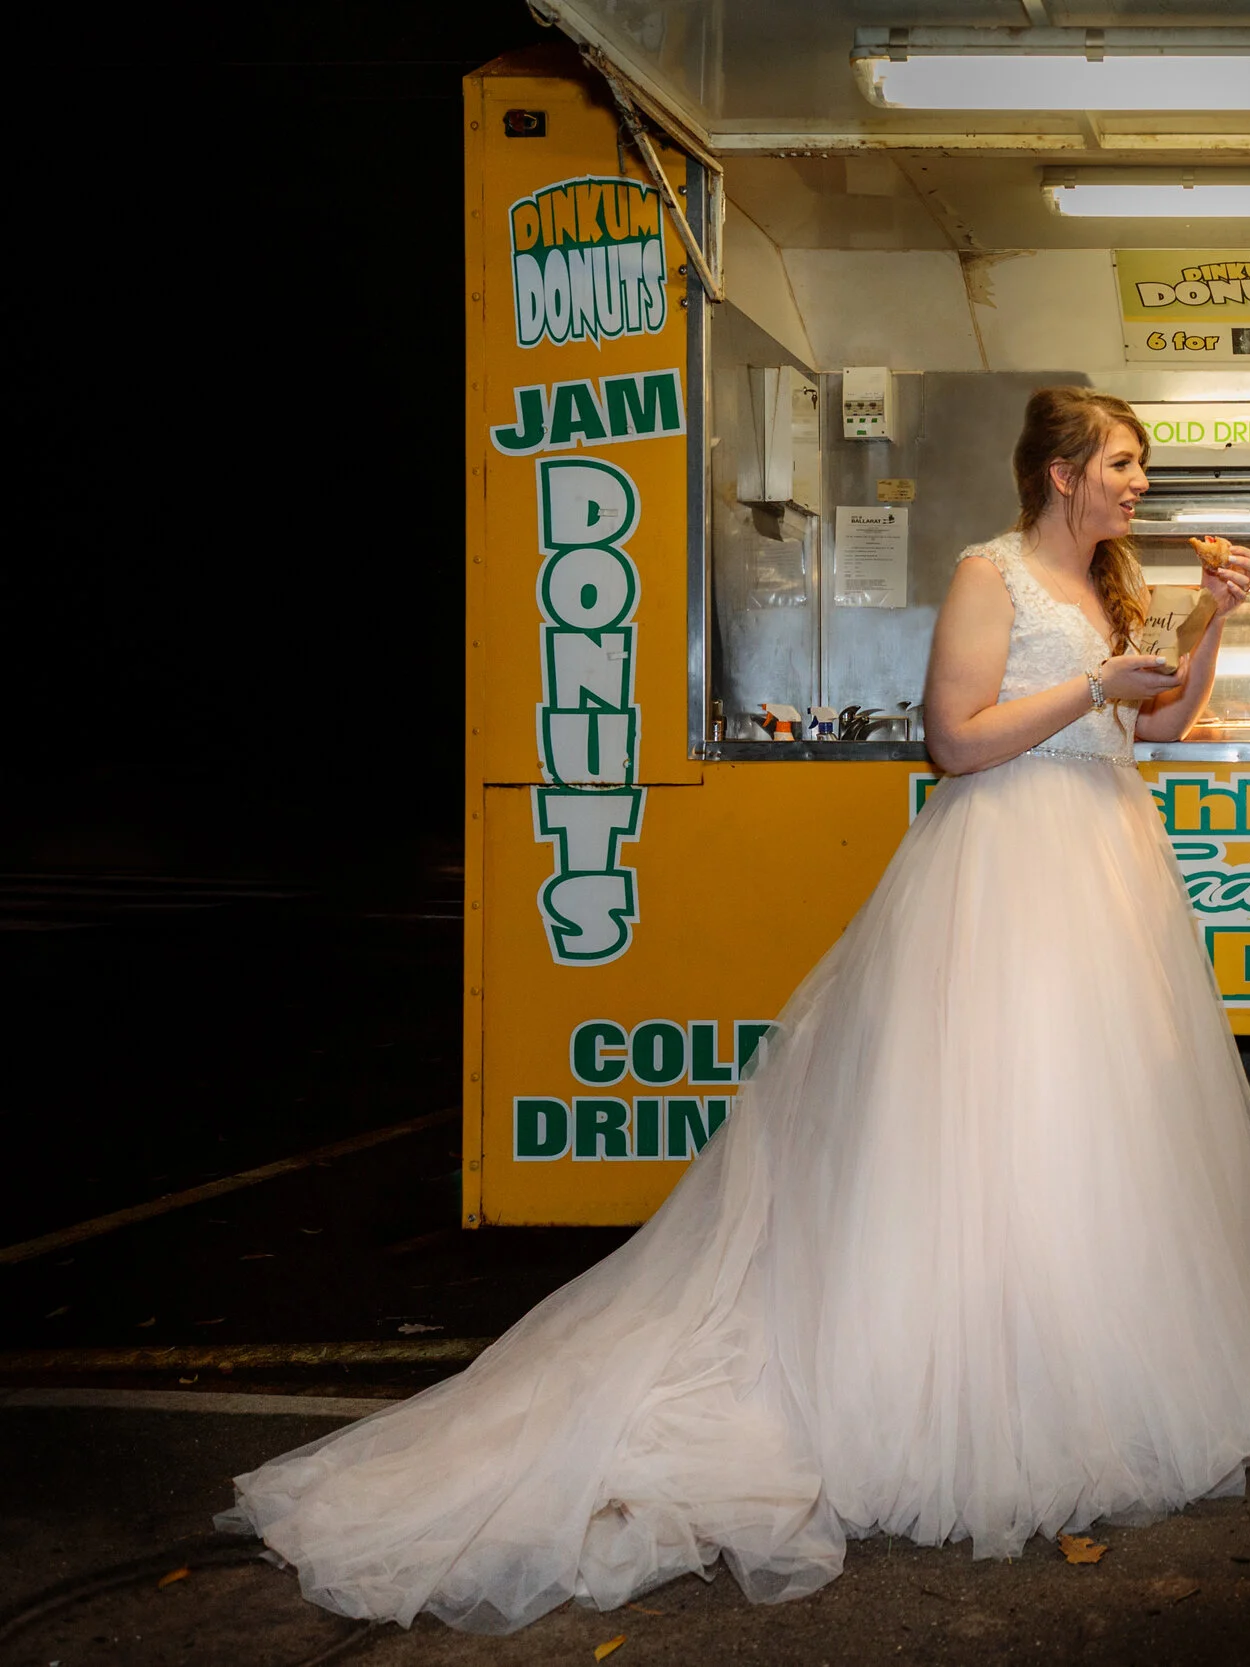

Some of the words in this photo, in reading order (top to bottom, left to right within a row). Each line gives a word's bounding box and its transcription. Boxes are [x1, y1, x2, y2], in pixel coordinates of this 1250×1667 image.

[511, 183, 661, 251] DINKUM
[514, 238, 666, 347] DONUTS
[1147, 332, 1166, 350] 6
[1172, 331, 1220, 350] for
[494, 371, 683, 452] JAM
[536, 458, 643, 962] DONUTS
[514, 1097, 729, 1160] DRIN
